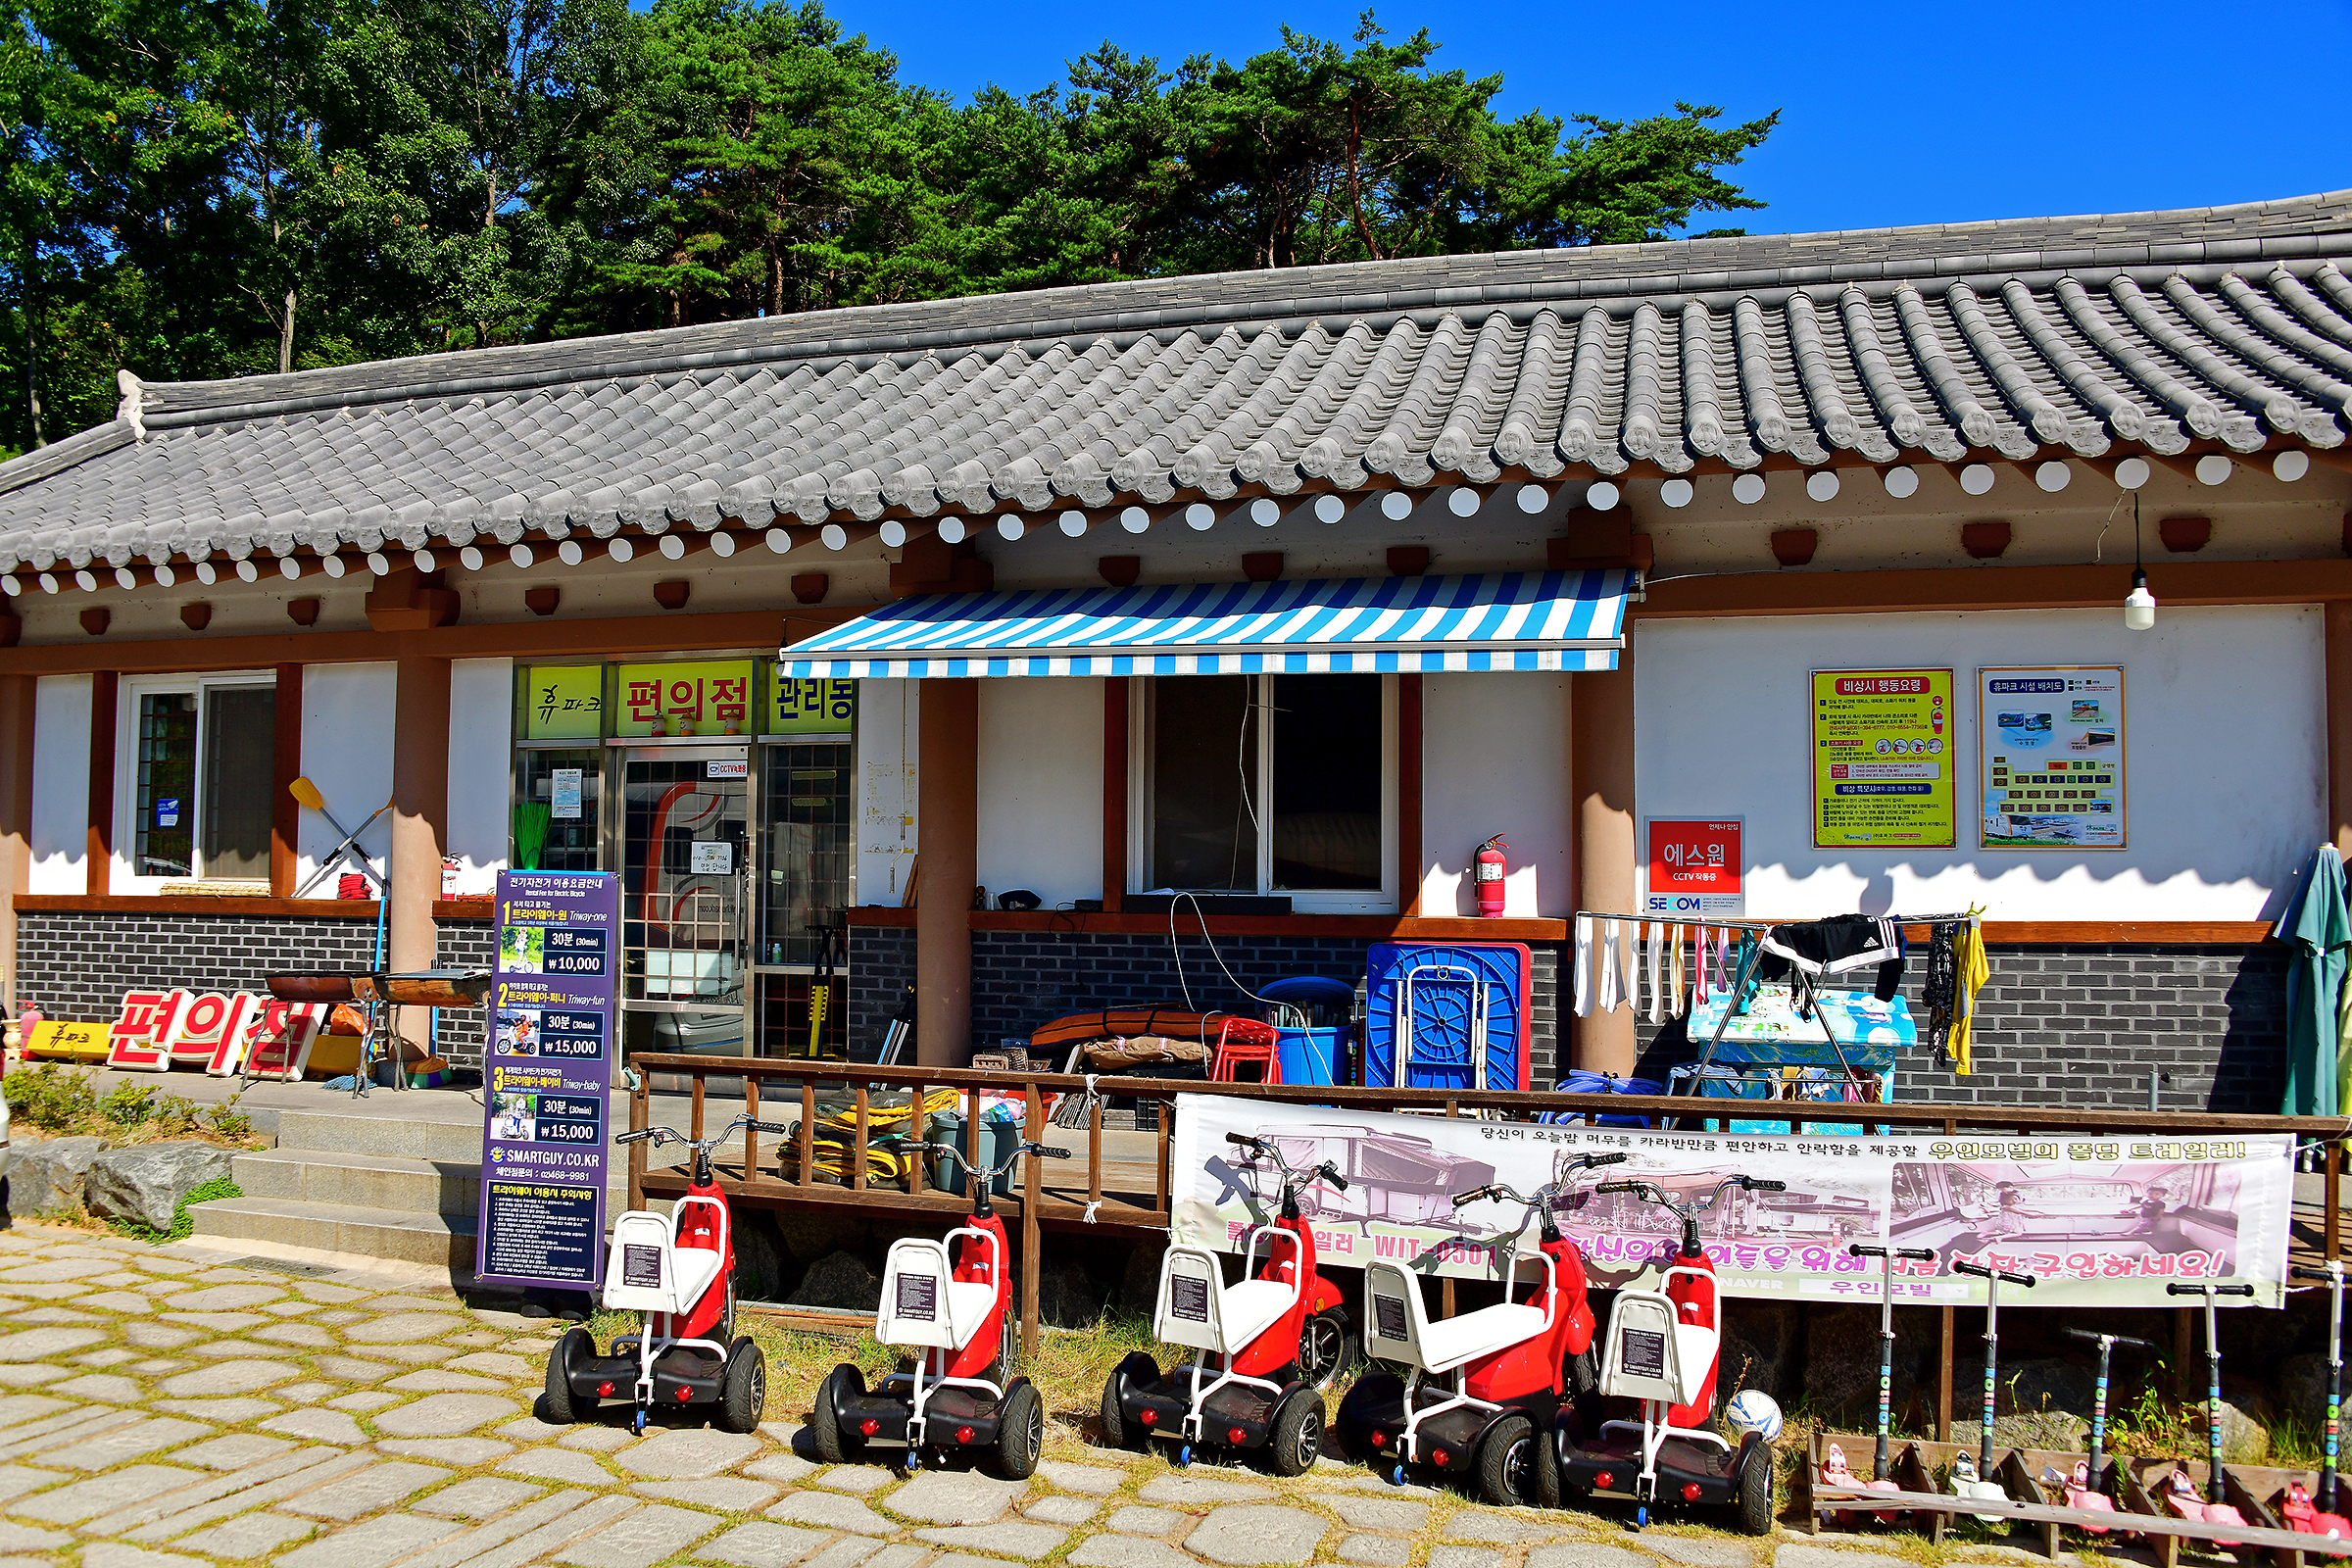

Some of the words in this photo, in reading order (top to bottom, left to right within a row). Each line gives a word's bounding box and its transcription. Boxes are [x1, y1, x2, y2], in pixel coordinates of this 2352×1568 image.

[1843, 680, 1875, 692] 비상시
[1879, 679, 1921, 692] 행동요령
[1993, 681, 2018, 692] 휴파크
[2020, 681, 2035, 691] 시설
[2037, 681, 2062, 691] 배치도
[627, 677, 747, 722] 편의점
[777, 678, 853, 719] 관리동
[1664, 843, 1725, 867] 에스원
[510, 877, 551, 888] 전기자전거
[554, 878, 603, 889] 이용요금안내
[1649, 897, 1700, 910] SECOM
[502, 901, 511, 925] 1
[512, 908, 567, 921] 트라이웨이-원
[569, 909, 608, 922] Triway-one
[552, 932, 573, 947] 30분
[575, 938, 599, 948] (30min)
[497, 982, 509, 1007] 2
[568, 994, 606, 1006] Triway-fun
[548, 1015, 570, 1030] 30분
[572, 1021, 596, 1030] (30min)
[108, 988, 323, 1081] 편의점
[493, 1066, 504, 1092] 3
[504, 1075, 562, 1089] 트라이웨이-베이비
[563, 1078, 601, 1092] Triway-baby
[544, 1100, 567, 1115] 30분
[569, 1105, 592, 1115] (30min)
[1481, 1127, 1526, 1141] 당신이
[1533, 1130, 1578, 1145] 오늘밤
[1586, 1134, 1632, 1148] 머무를
[1640, 1137, 1718, 1152] 카라반만큼
[1726, 1140, 1788, 1153] 편안하고
[1797, 1143, 1862, 1157] 안락함을
[1869, 1145, 1918, 1157] 제공할
[1929, 1141, 2059, 1160] 우인모빌의
[2068, 1142, 2120, 1161] 폴딩
[2128, 1141, 2246, 1160] 트레일러!
[507, 1149, 600, 1168] SMARTGUY.CO.KR
[495, 1166, 533, 1178] 체인점문의
[492, 1184, 532, 1197] 트라이웨이
[533, 1186, 558, 1199] 이용시
[561, 1189, 593, 1201] 주의사항
[1375, 1236, 1497, 1266] WIT-0501
[1801, 1245, 1868, 1272] 위해
[2033, 1250, 2225, 1278] 구입하세요!
[1723, 1278, 1784, 1292] NAVER
[1830, 1281, 1932, 1298] 우인모빌
